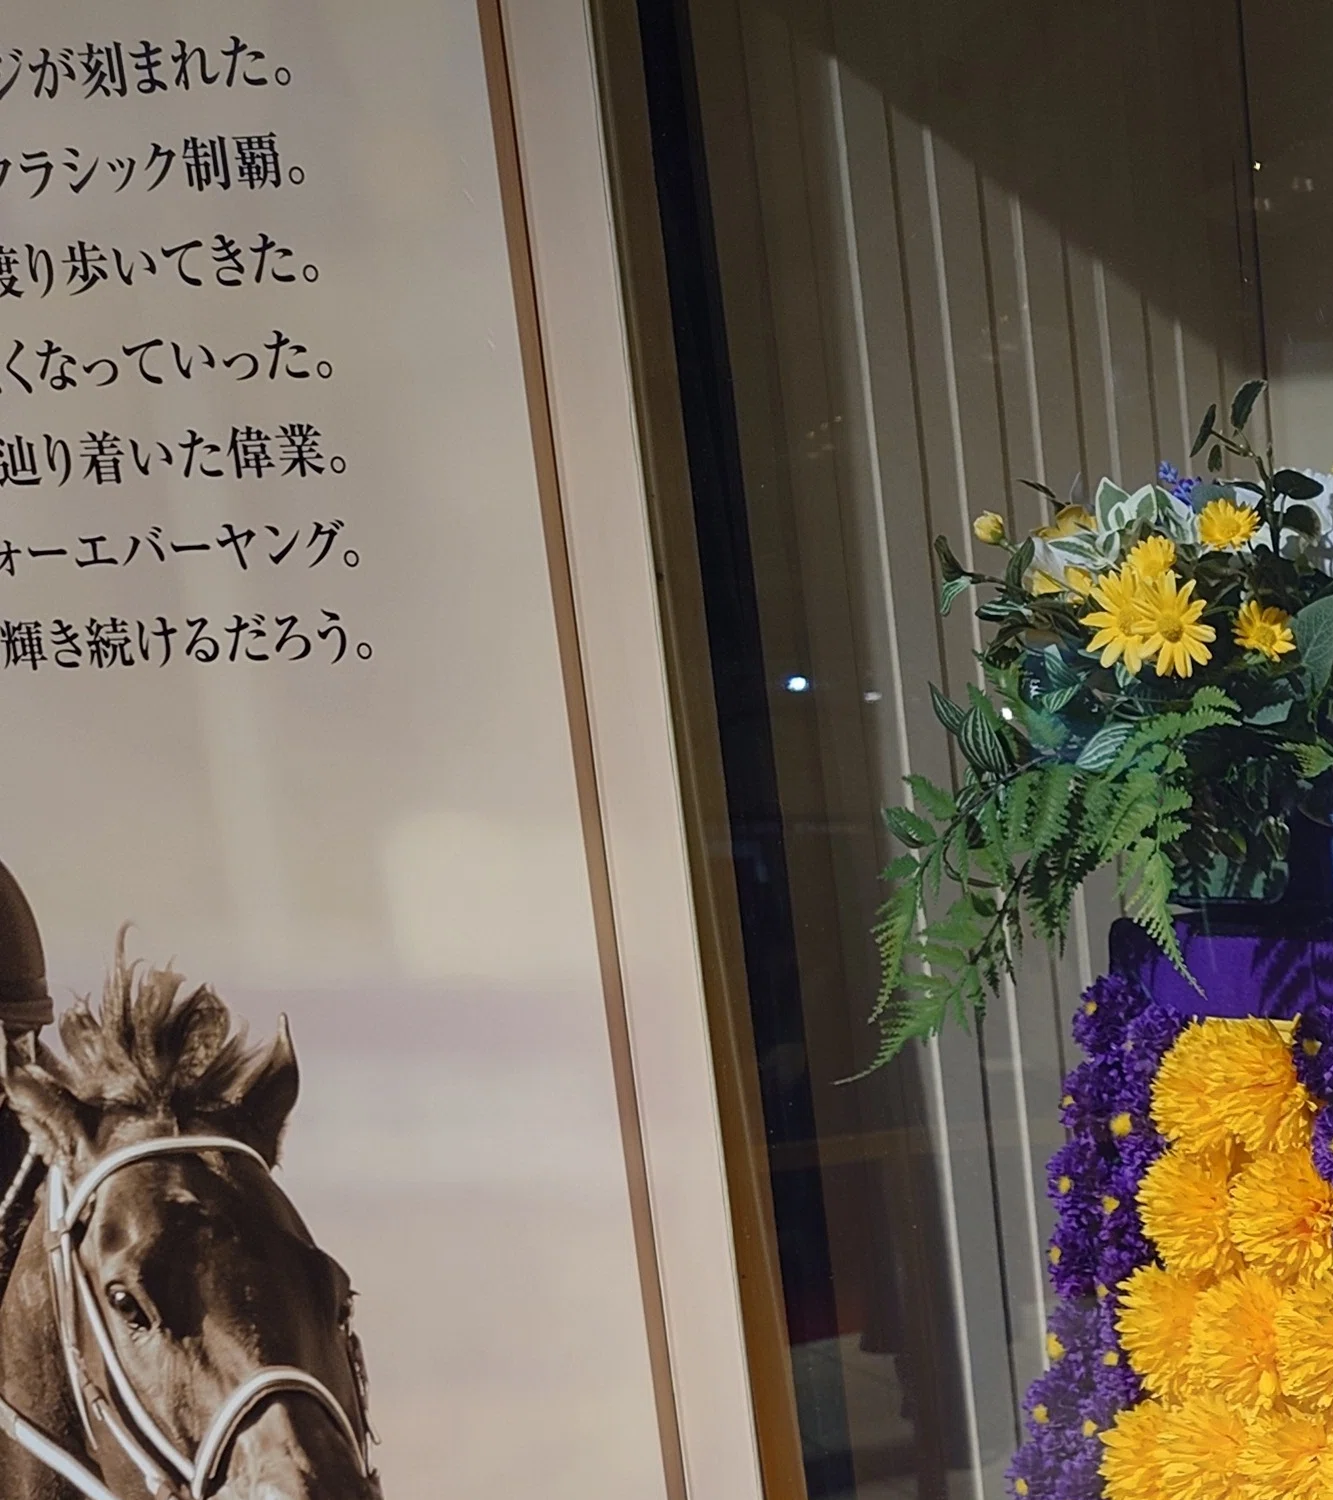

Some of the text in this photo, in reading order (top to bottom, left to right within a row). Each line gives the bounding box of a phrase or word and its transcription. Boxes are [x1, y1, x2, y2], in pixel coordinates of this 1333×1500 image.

[0, 423, 346, 487] 辿り着いた偉業。
[0, 609, 372, 670] 輝き続けるだろう。
